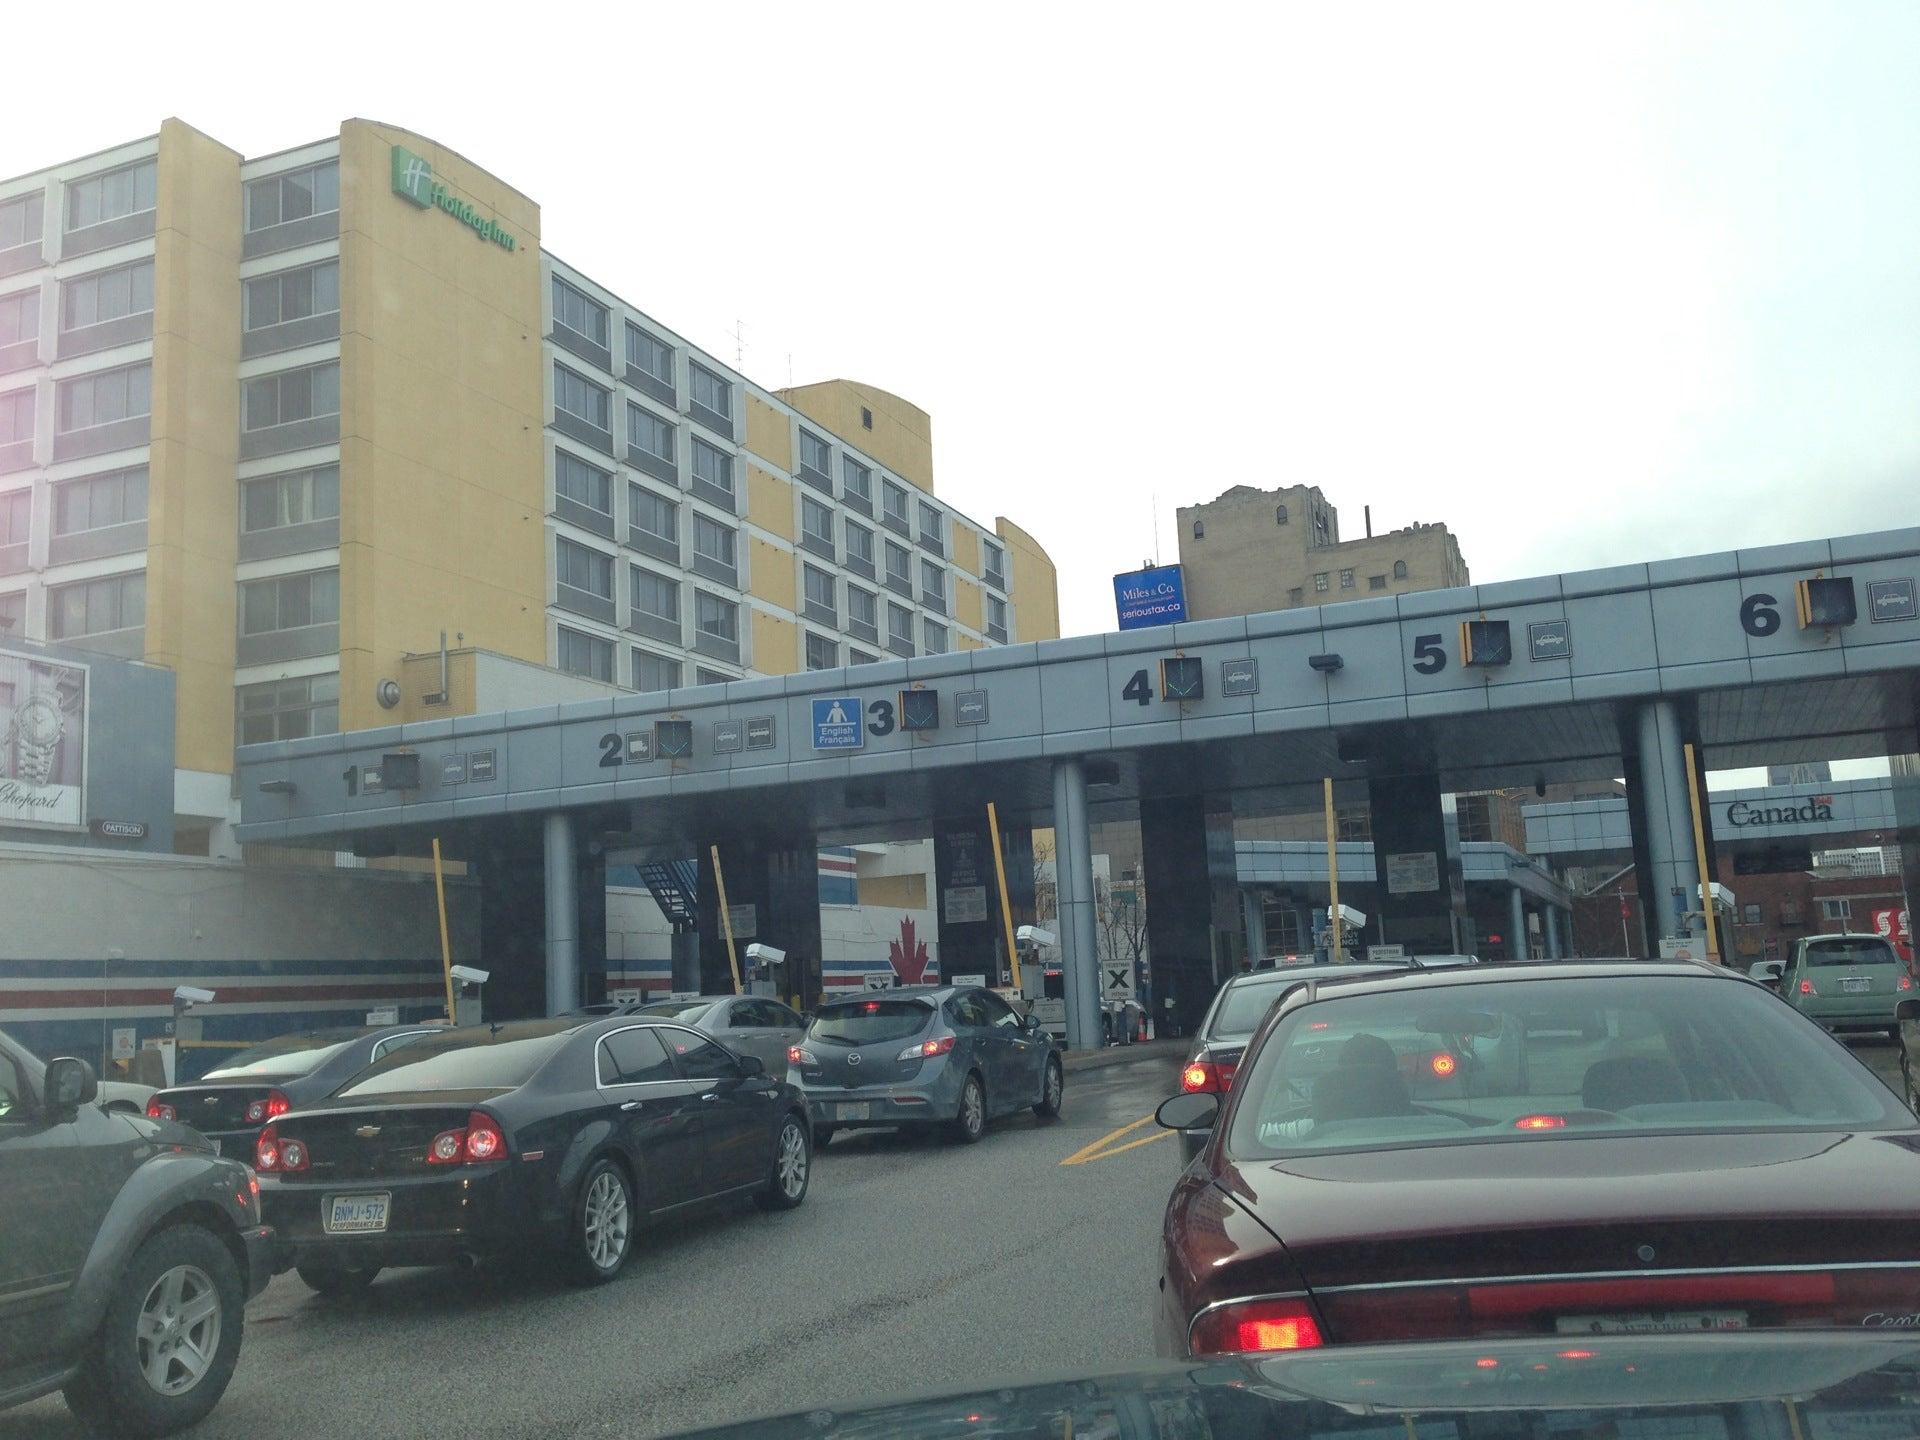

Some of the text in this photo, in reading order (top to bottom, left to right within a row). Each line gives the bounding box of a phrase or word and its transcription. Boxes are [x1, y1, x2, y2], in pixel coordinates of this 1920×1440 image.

[431, 182, 516, 252] Holiday Inn
[1123, 588, 1149, 600] Miles
[1158, 583, 1176, 595] Co.
[1122, 603, 1180, 619] serioustax.ca
[1740, 594, 1781, 637] 6
[1413, 634, 1447, 675] 5
[1122, 669, 1153, 706] 4
[821, 726, 853, 736] English
[868, 700, 894, 736] 3
[599, 733, 623, 767] 2
[819, 736, 855, 745] Français
[343, 766, 357, 796] 1
[0, 782, 64, 809] Chopard
[1727, 798, 1834, 825] Canada
[105, 824, 141, 834] PATTISON
